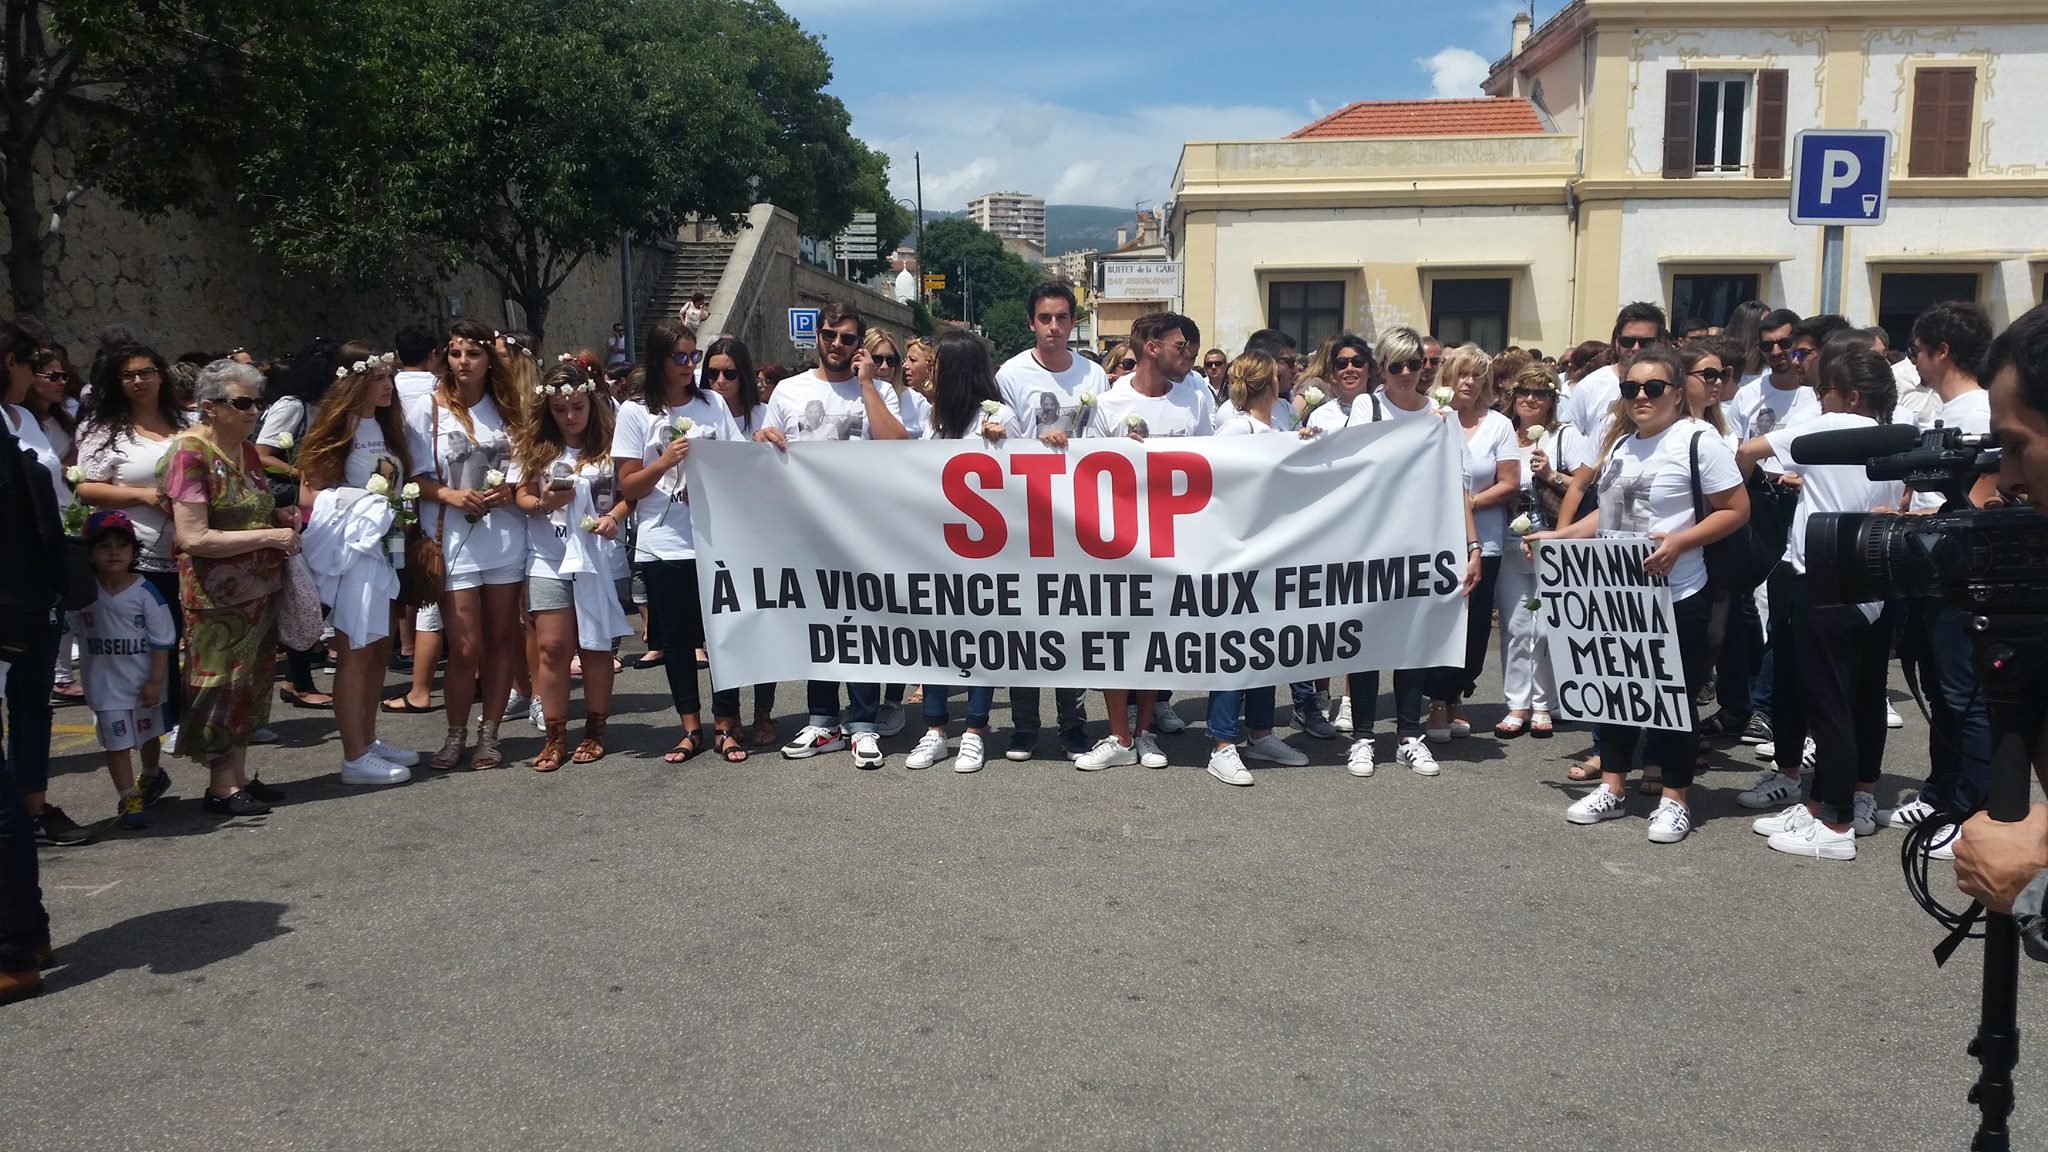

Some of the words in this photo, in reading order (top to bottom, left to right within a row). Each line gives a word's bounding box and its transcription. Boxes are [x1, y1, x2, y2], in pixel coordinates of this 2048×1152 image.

[1819, 149, 1862, 204] P
[1107, 265, 1134, 273] BUFFET
[1155, 264, 1176, 273] GARE
[800, 316, 810, 330] P
[941, 451, 1212, 558] STOP
[711, 560, 741, 614] À
[753, 567, 807, 610] LA
[815, 568, 1022, 617] VIOLENCE
[1036, 573, 1154, 617] FAITE
[1169, 569, 1260, 618] AUX
[1275, 550, 1460, 611] FEMMES
[1541, 590, 1670, 634] JOANNA
[808, 615, 1067, 679] DÉNONÇONS
[1081, 631, 1130, 672] ET
[1144, 618, 1364, 674] AGISSONS
[1567, 632, 1674, 681] MÊME
[1559, 680, 1686, 728] COMBAT
